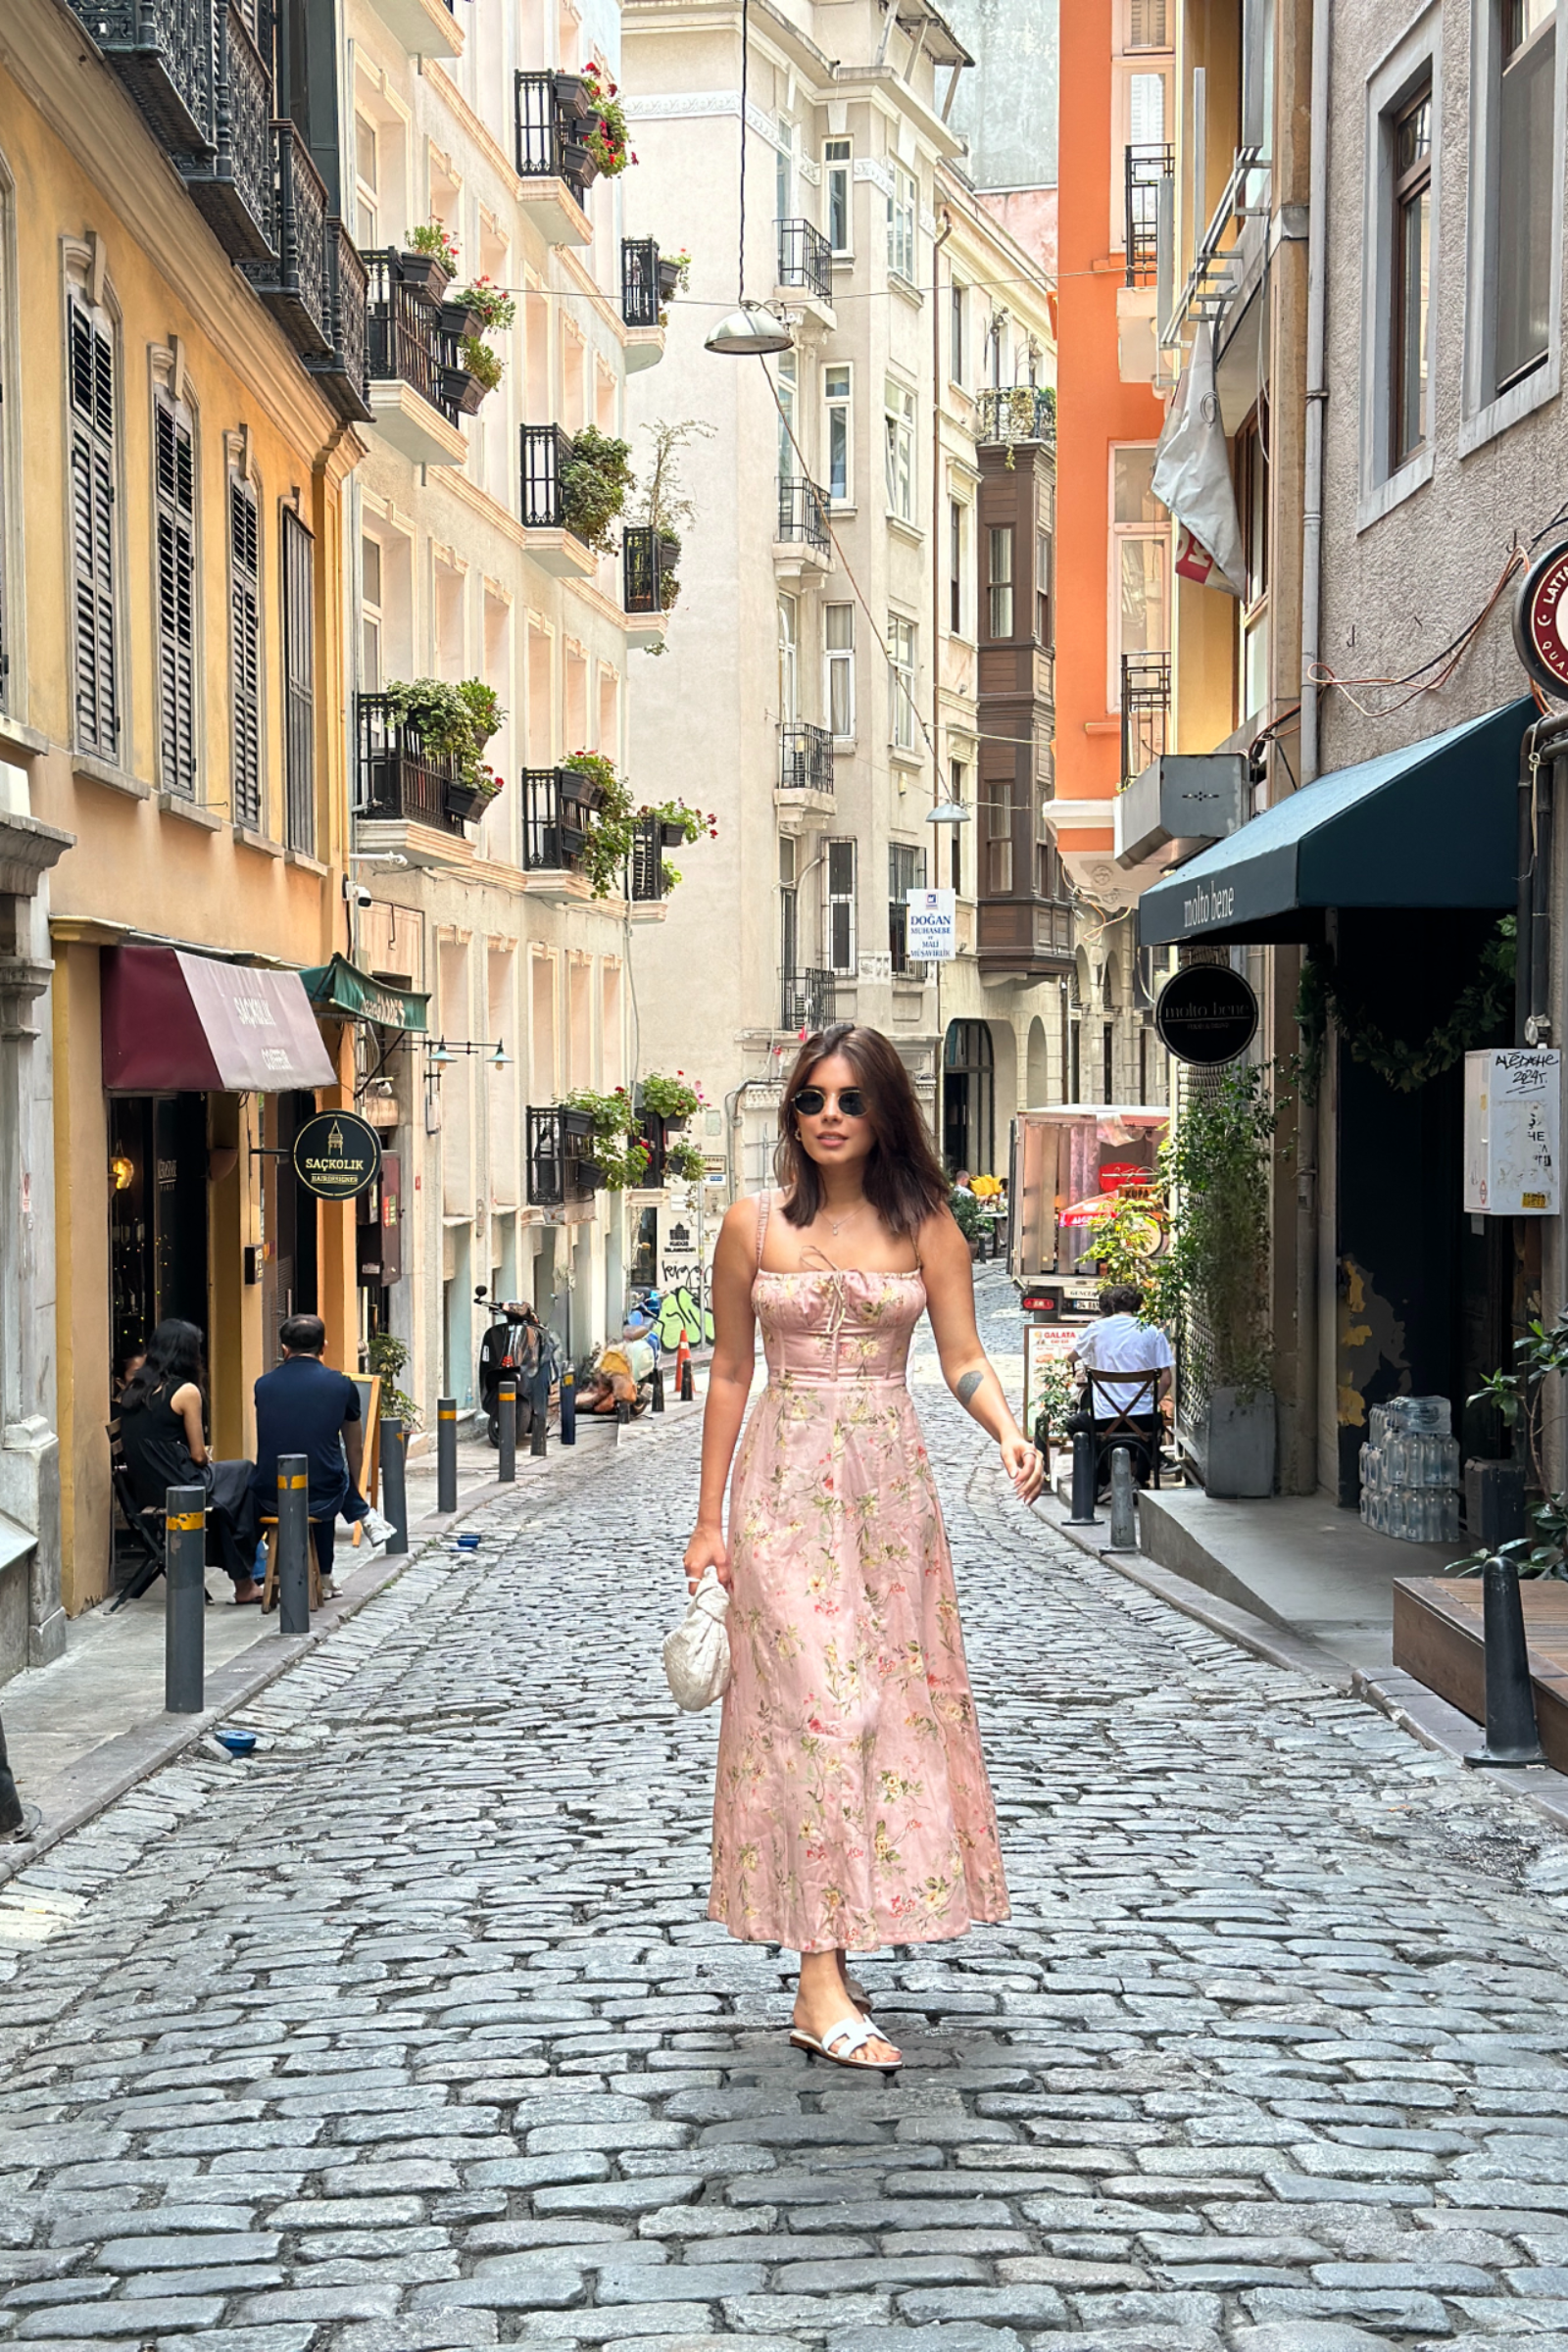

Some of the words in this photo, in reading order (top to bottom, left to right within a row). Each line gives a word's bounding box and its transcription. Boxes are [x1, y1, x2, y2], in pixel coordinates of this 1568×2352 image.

[1184, 884, 1210, 928] molto
[1210, 880, 1235, 920] bene
[910, 913, 952, 925] DOĞAN
[1165, 1002, 1207, 1018] molto
[1213, 1001, 1250, 1016] bene
[305, 1157, 364, 1172] SAÇKOLIK
